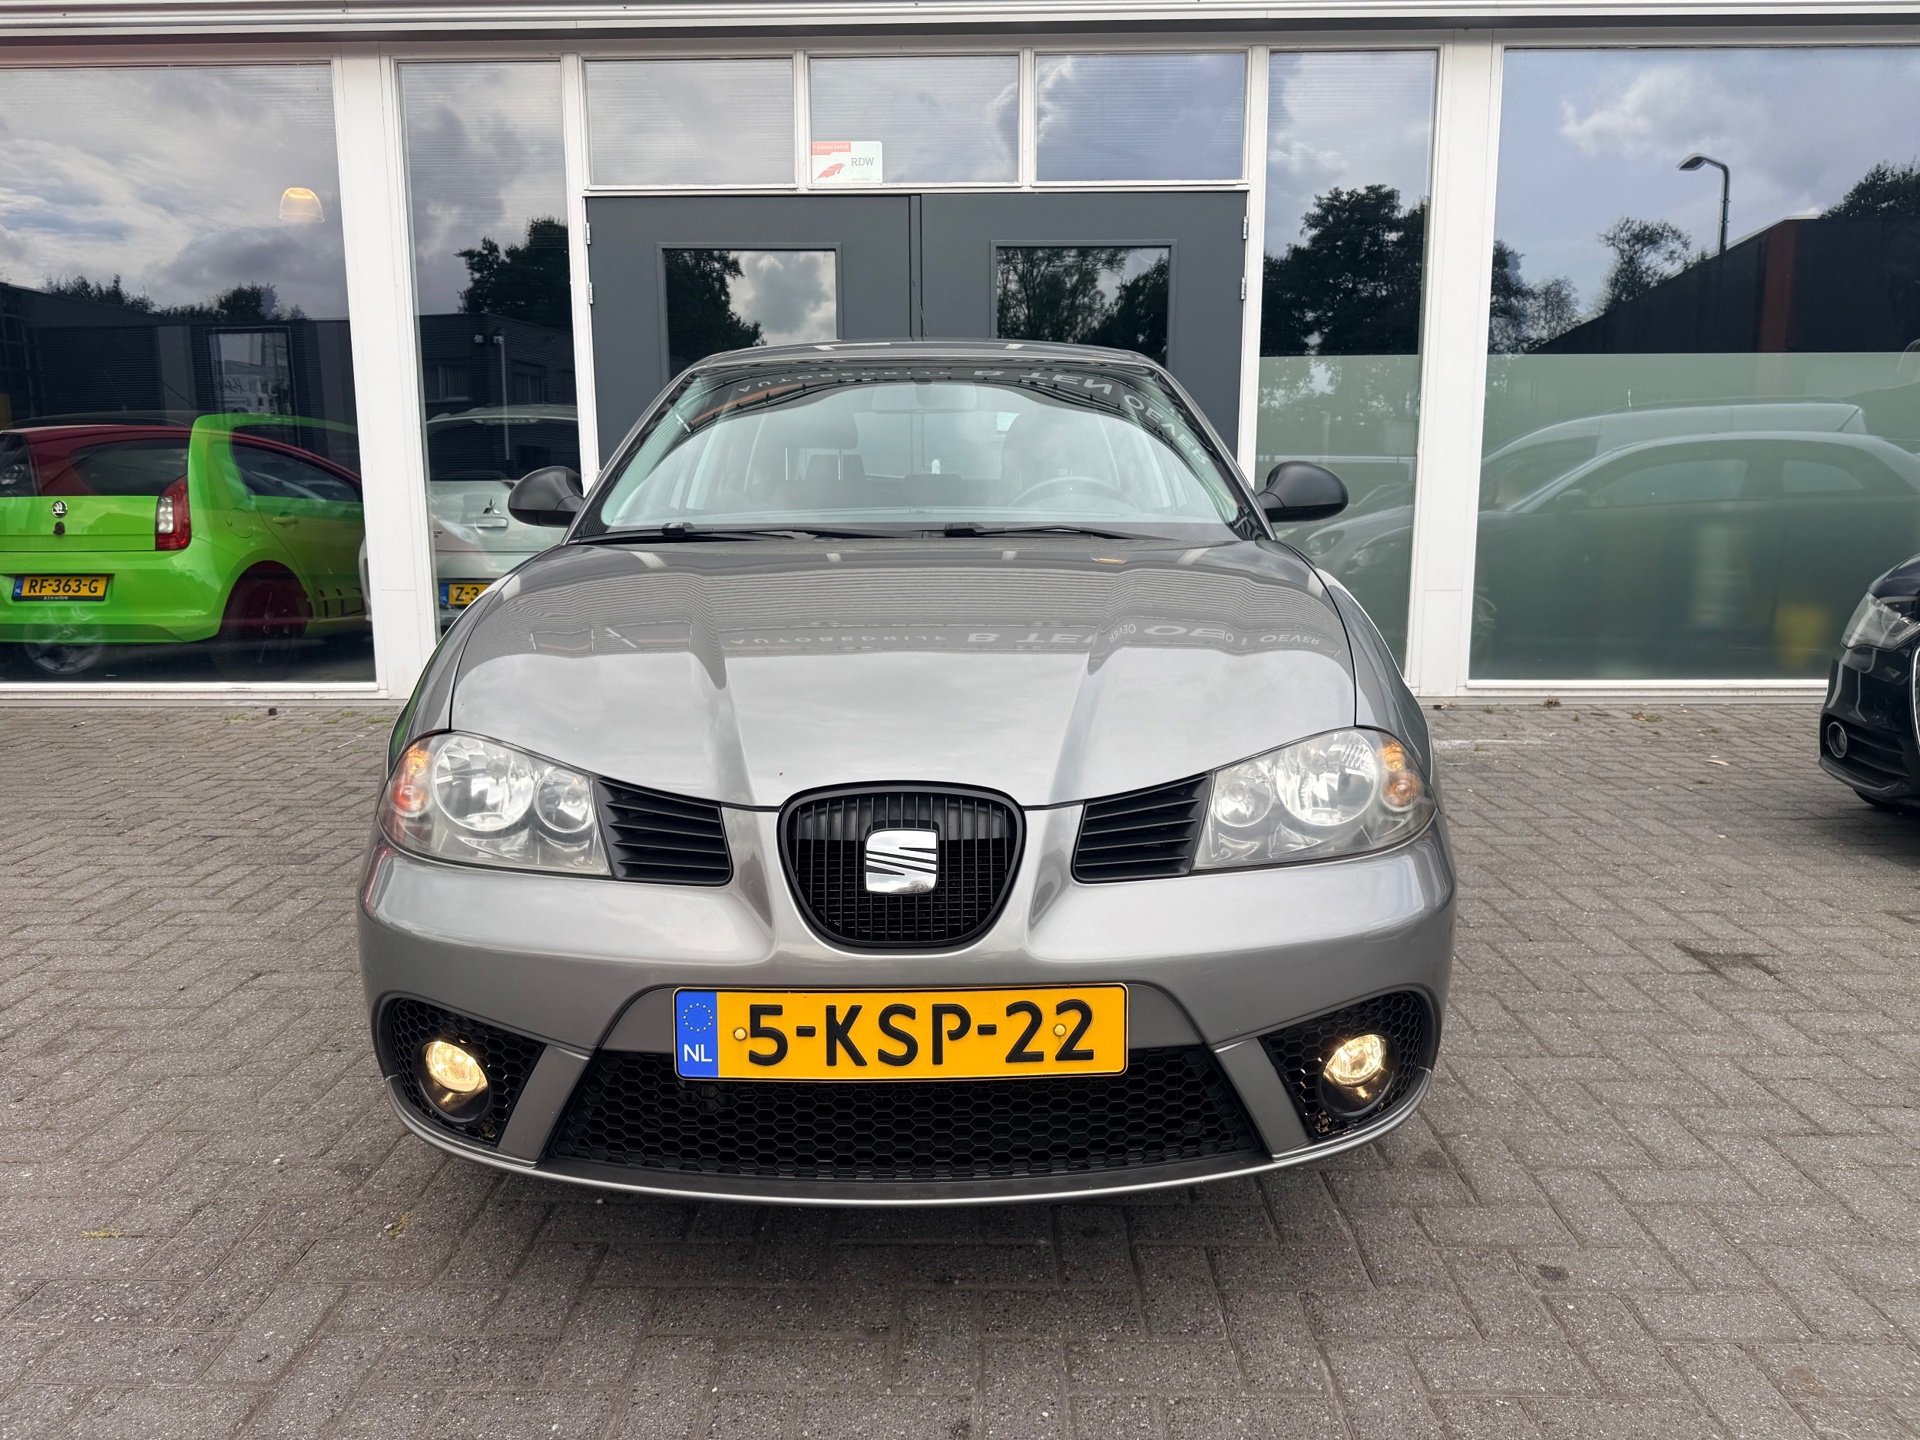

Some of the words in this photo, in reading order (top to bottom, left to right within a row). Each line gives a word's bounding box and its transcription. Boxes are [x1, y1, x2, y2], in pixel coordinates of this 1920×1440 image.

[851, 157, 875, 167] RDW
[28, 578, 99, 593] RF-363-G
[748, 999, 1095, 1067] 5-KSP-22
[683, 1044, 712, 1062] NL
